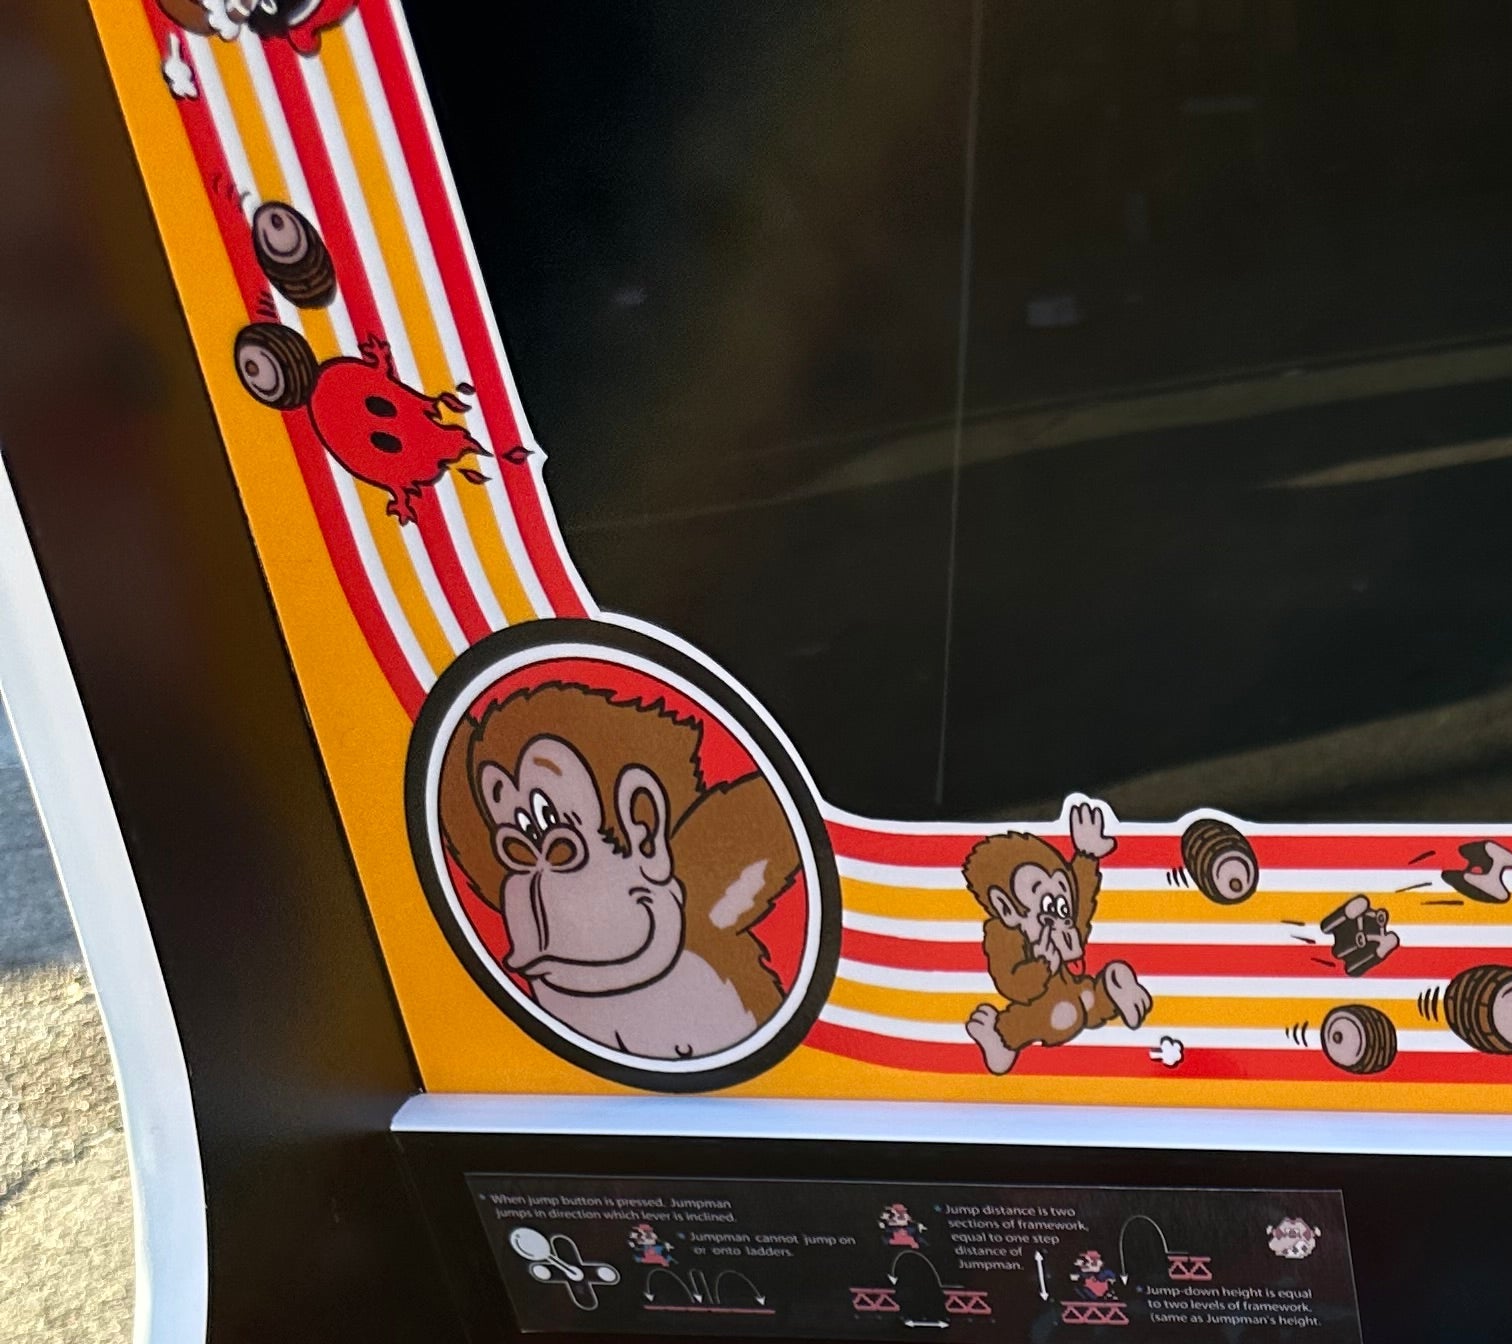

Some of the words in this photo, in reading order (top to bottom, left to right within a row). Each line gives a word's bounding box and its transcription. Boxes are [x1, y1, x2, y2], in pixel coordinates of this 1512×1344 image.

[491, 1195, 526, 1205] When
[528, 1196, 560, 1207] jump
[562, 1196, 602, 1207] button
[604, 1197, 615, 1207] is
[670, 1198, 732, 1211] Jumpman
[535, 1208, 547, 1218] in
[549, 1208, 602, 1219] direction
[603, 1209, 640, 1220] which
[642, 1210, 672, 1221] lever
[674, 1212, 684, 1221] is
[945, 1204, 980, 1217] Jump
[982, 1205, 1036, 1216] distance
[1038, 1206, 1049, 1217] is
[1050, 1207, 1076, 1217] two
[948, 1219, 1000, 1229] sections
[1002, 1219, 1015, 1229] of
[689, 1232, 751, 1244] Jumpman
[755, 1234, 800, 1244] cannot
[803, 1234, 837, 1246] jump
[839, 1236, 857, 1245] on
[951, 1232, 987, 1244] equal
[989, 1233, 1003, 1243] to
[1005, 1234, 1030, 1244] one
[1033, 1235, 1060, 1246] step
[693, 1246, 707, 1255] or
[712, 1246, 742, 1255] onto
[954, 1246, 1008, 1257] distance
[1009, 1246, 1023, 1257] of
[1221, 1286, 1262, 1299] height
[1265, 1288, 1276, 1298] is
[1277, 1288, 1312, 1300] equal
[1148, 1300, 1161, 1309] to
[1163, 1300, 1188, 1309] two
[1190, 1299, 1225, 1311] levels
[1227, 1300, 1240, 1310] of
[1190, 1314, 1203, 1323] as
[1206, 1313, 1277, 1326] Jumpman's
